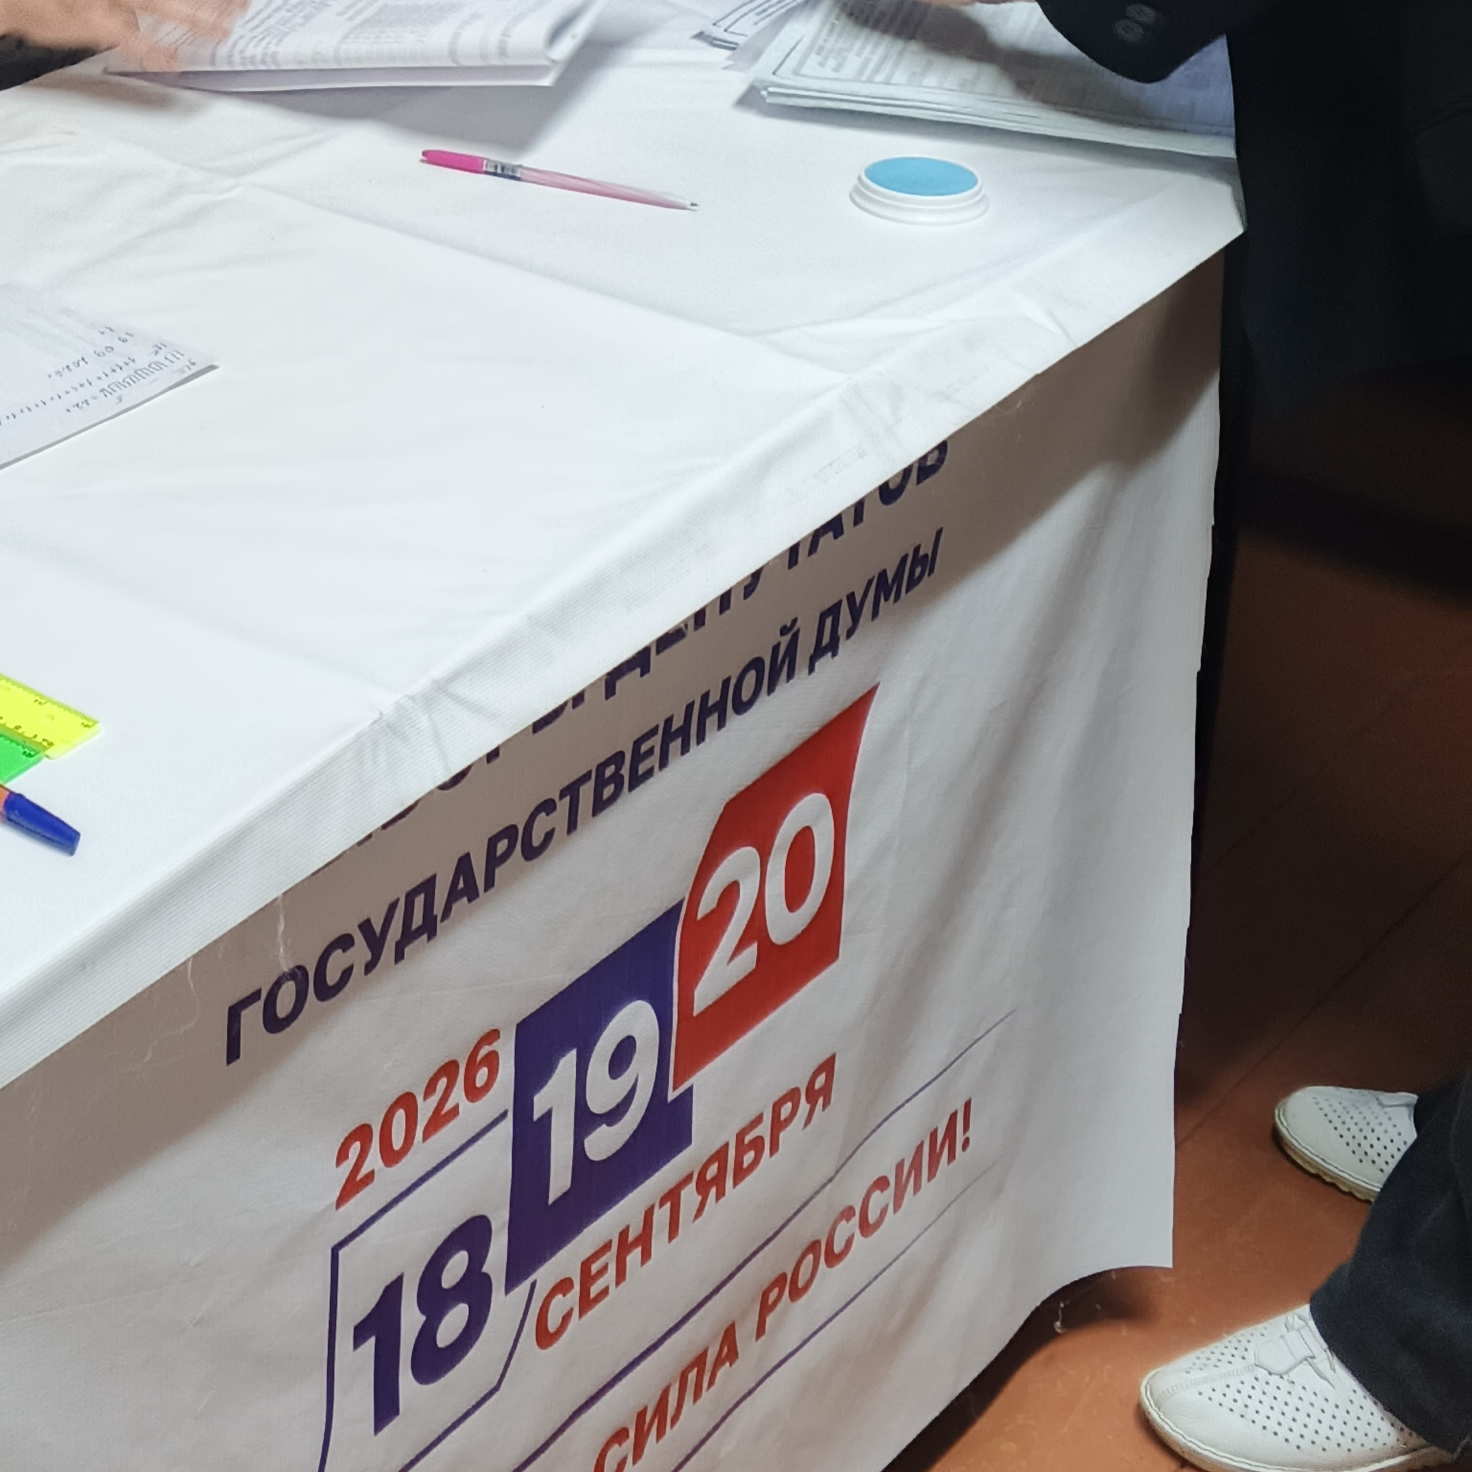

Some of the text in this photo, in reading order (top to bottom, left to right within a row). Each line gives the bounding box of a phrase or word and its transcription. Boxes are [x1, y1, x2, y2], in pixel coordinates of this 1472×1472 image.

[226, 617, 801, 1067] ГОСУДАРСТВЕННОЙ
[807, 526, 944, 676] ДУМЫ
[334, 1028, 501, 1211] 2026
[352, 1213, 494, 1437] 18
[532, 999, 661, 1207] 19
[692, 792, 835, 1018] 20
[534, 1052, 837, 1351] СЕНТЯБРЯ
[593, 1097, 972, 1472] СИЛА РОССИИ!
